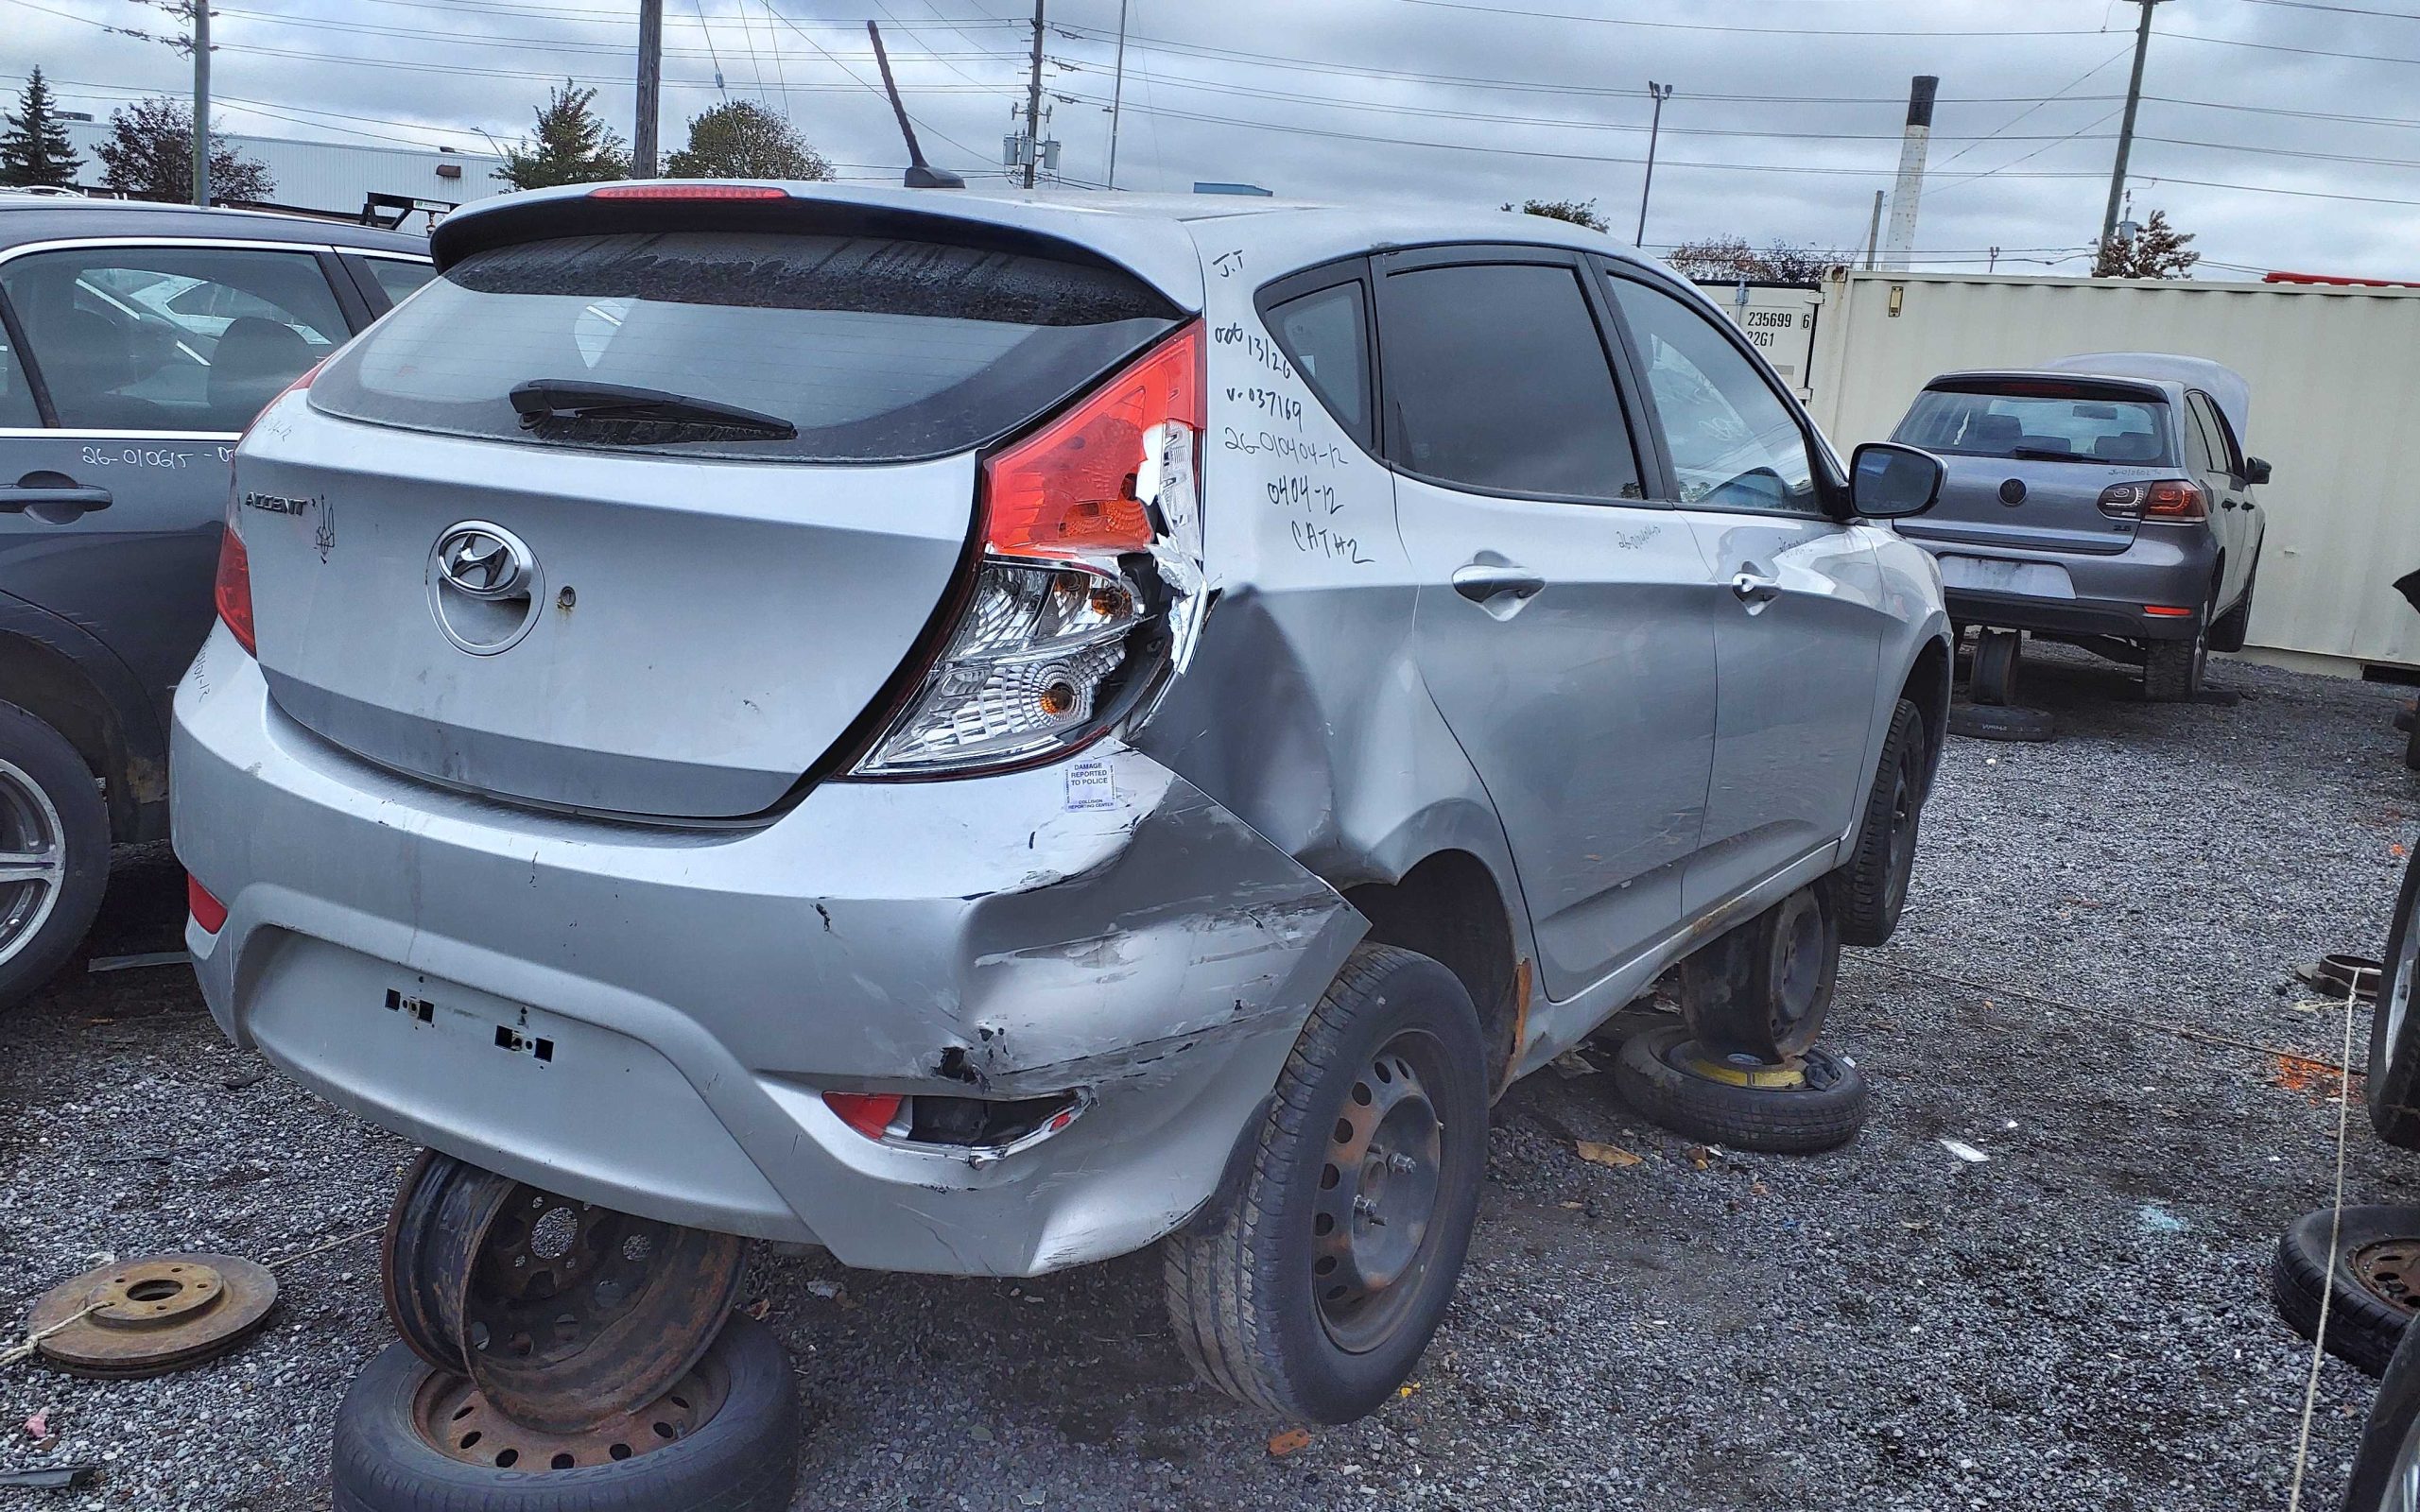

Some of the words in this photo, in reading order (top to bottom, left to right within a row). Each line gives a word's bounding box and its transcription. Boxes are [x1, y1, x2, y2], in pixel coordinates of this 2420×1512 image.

[1747, 312, 1792, 328] 235699
[1802, 314, 1810, 329] 6
[245, 491, 307, 516] ACCENT
[1070, 769, 1107, 779] REPORTED
